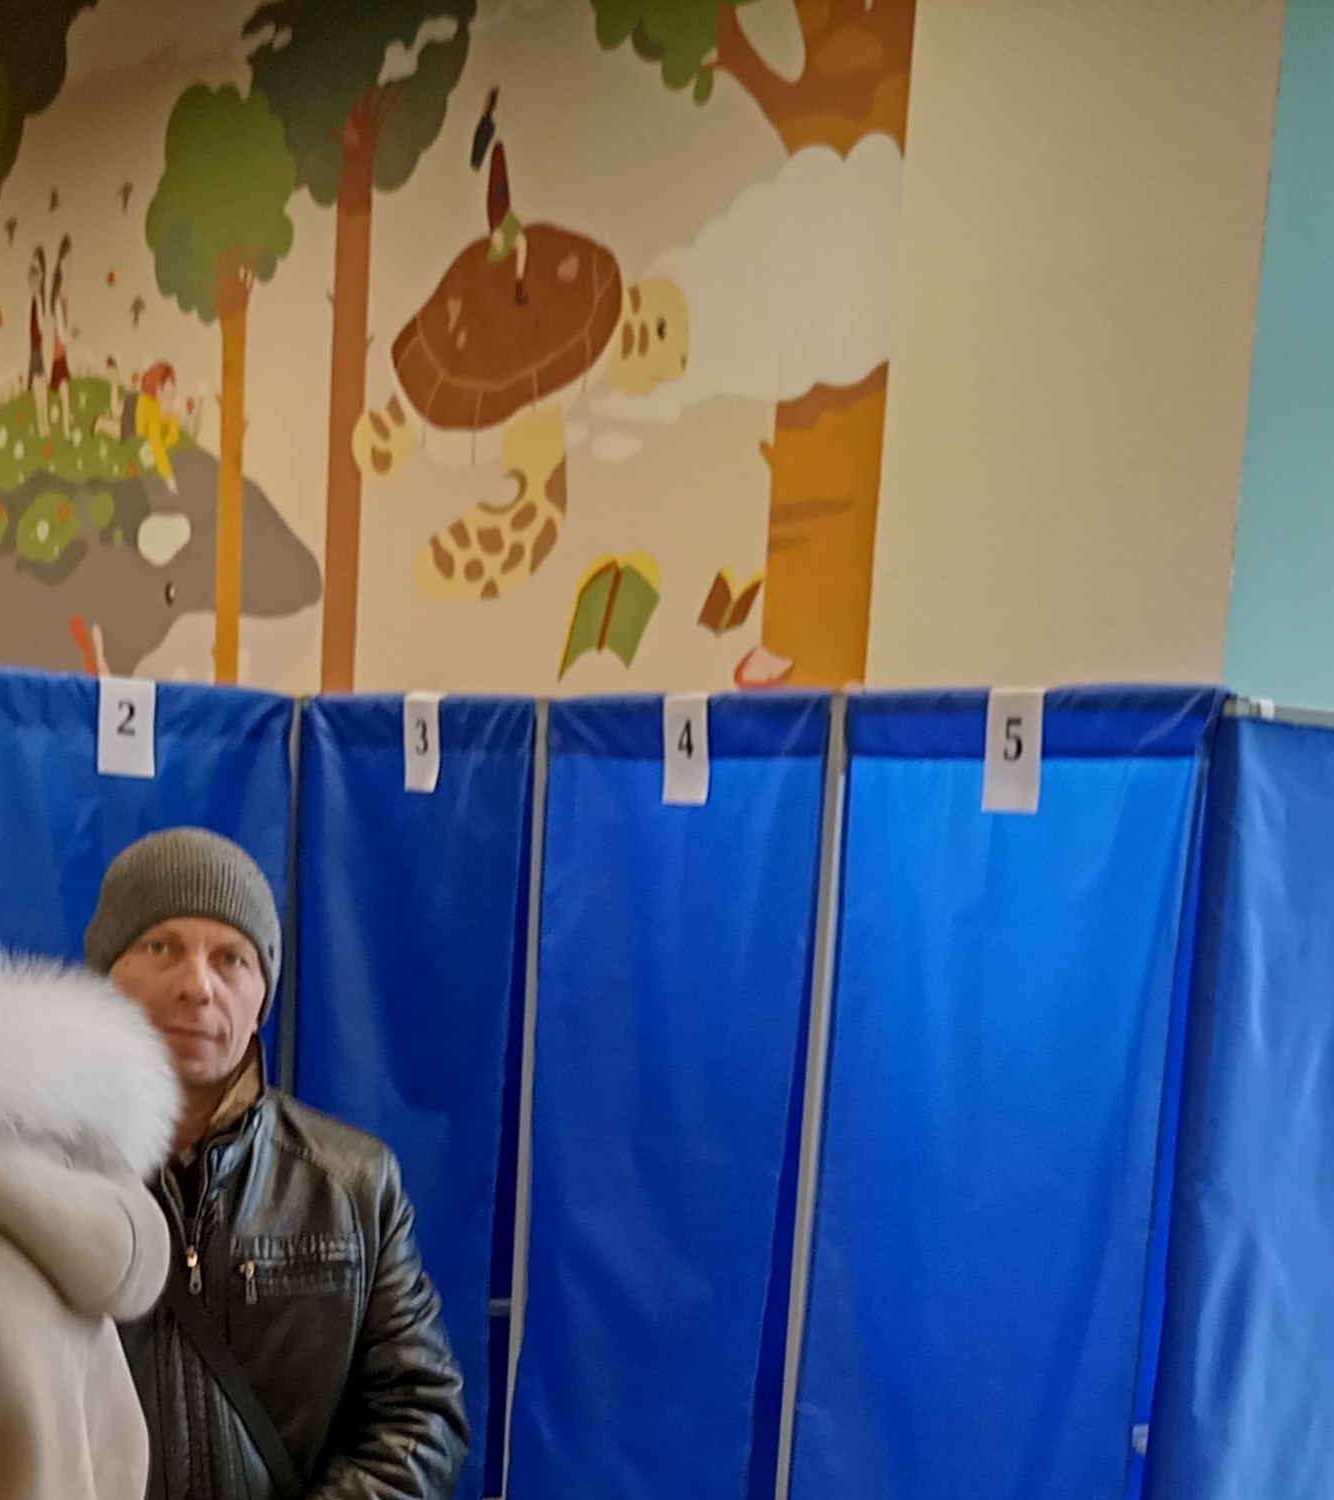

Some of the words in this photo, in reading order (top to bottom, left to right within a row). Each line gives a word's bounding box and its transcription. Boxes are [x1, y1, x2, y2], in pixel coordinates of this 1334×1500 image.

[116, 700, 136, 736] 2
[415, 718, 428, 756] 3
[677, 718, 695, 760] 4
[1003, 716, 1022, 762] 5
